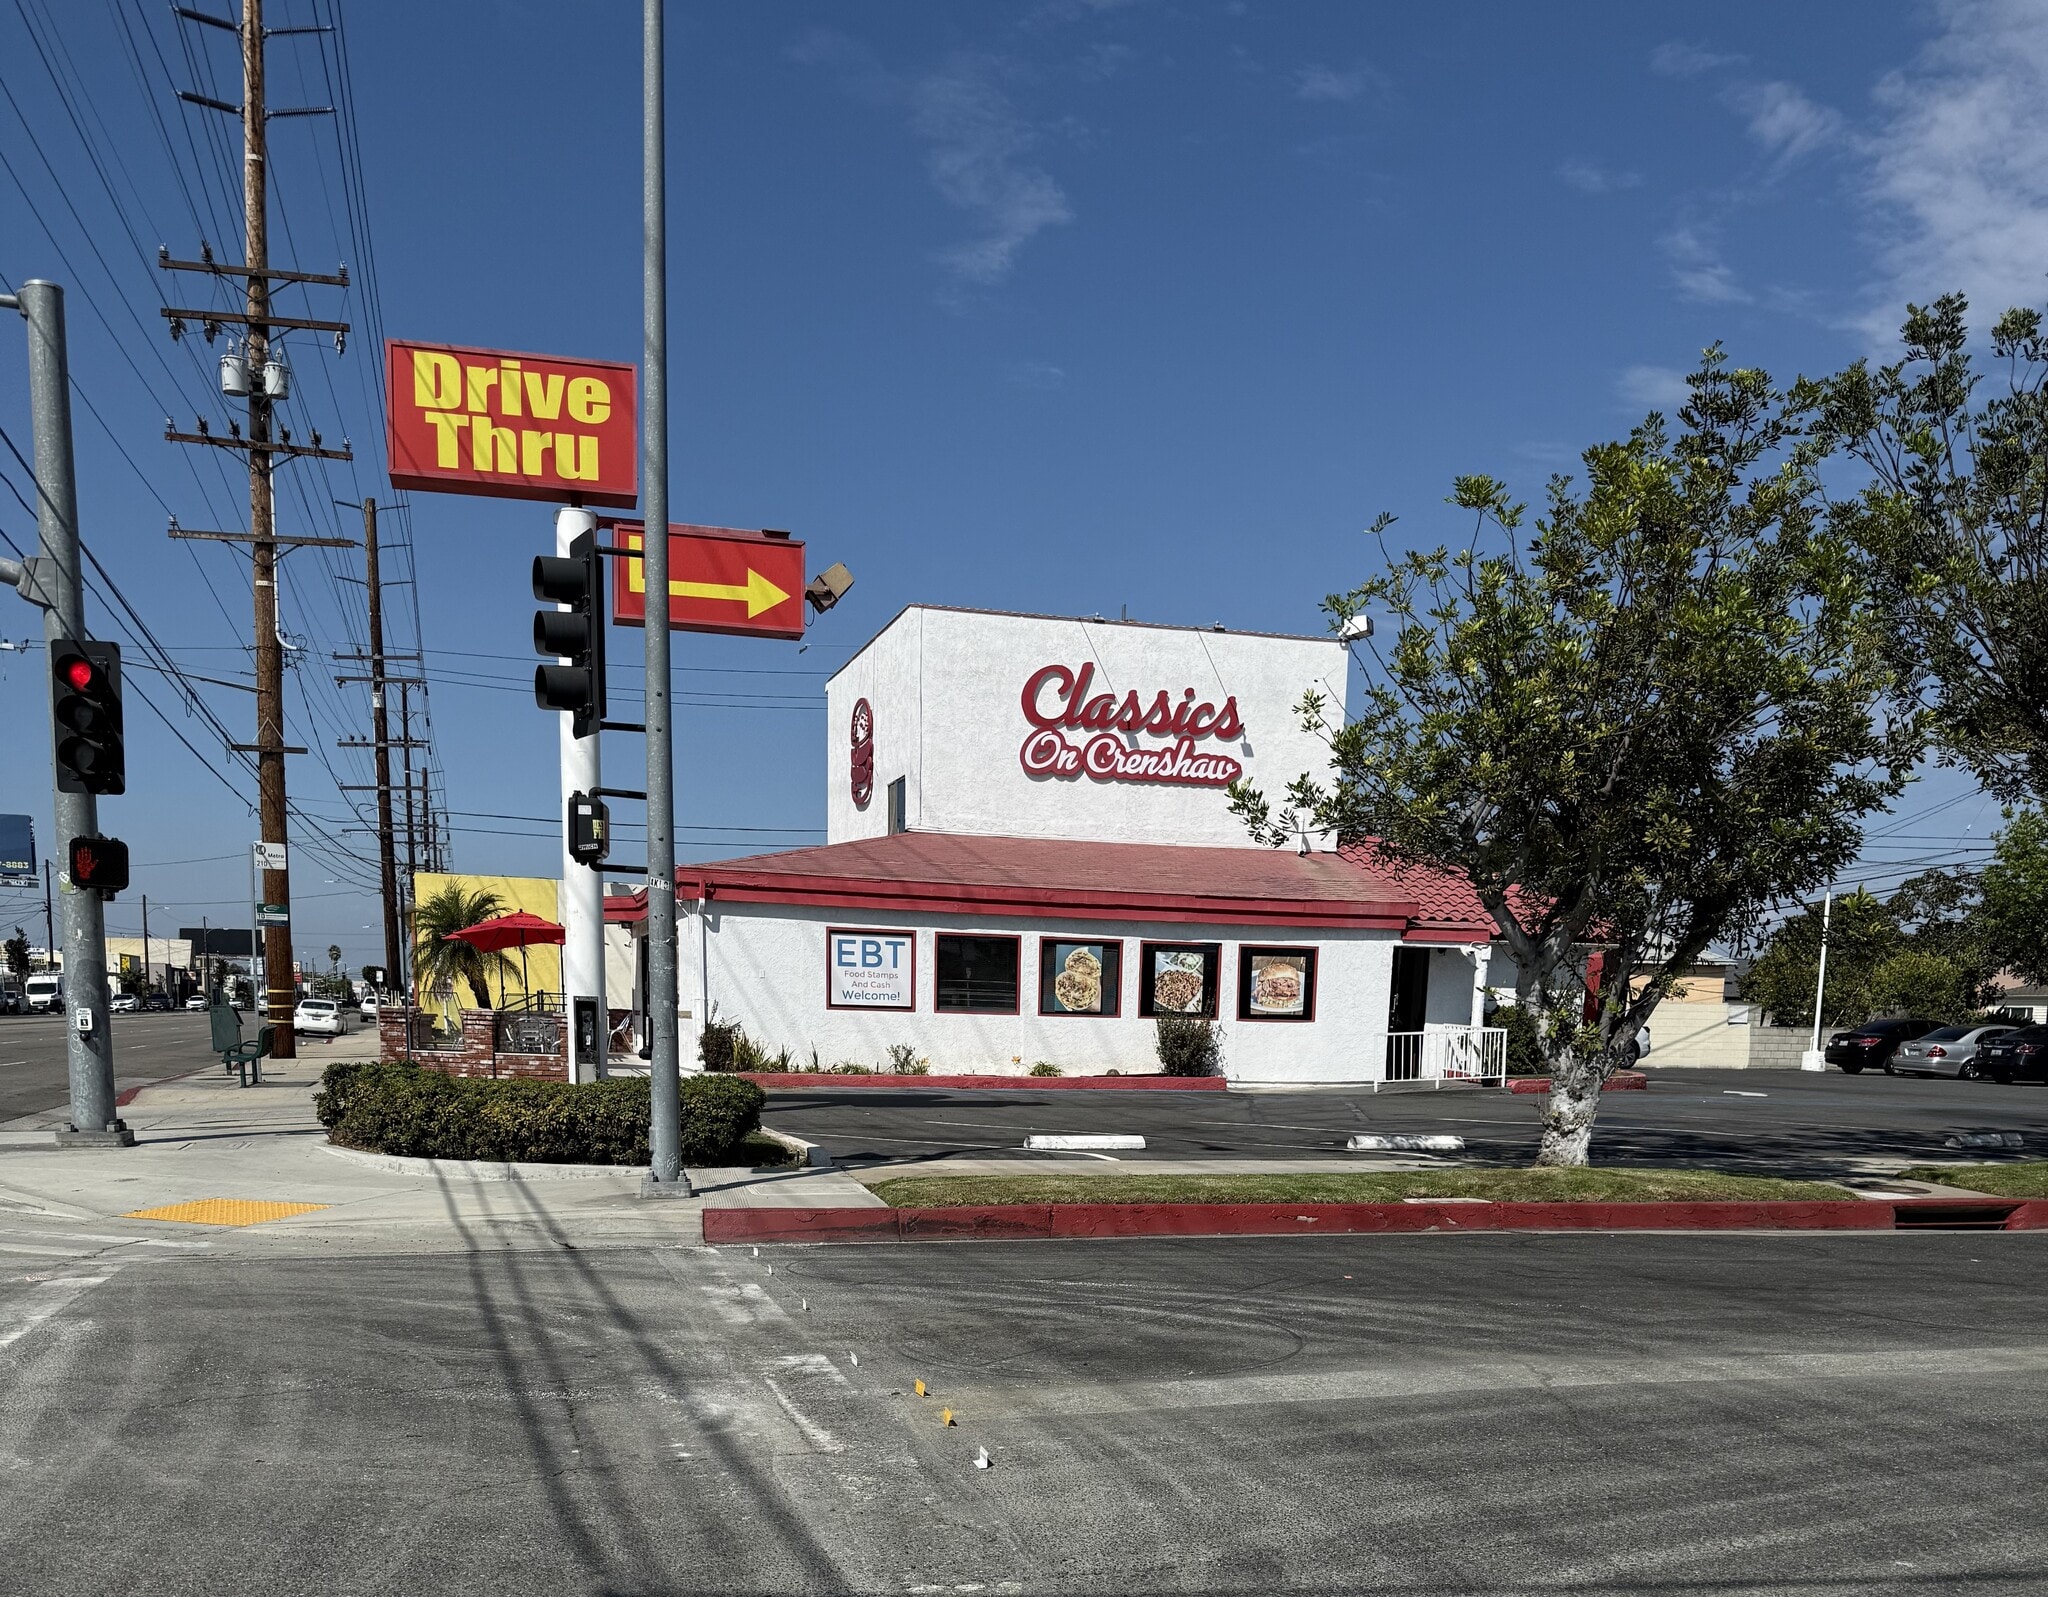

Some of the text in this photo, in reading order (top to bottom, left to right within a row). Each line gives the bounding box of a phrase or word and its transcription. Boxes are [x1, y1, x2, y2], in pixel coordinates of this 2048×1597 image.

[413, 350, 611, 425] Drive
[424, 411, 599, 482] Thru
[1021, 662, 1242, 739] Classics
[1023, 730, 1239, 780] On Crenshaw
[837, 938, 906, 969] EBT
[842, 989, 900, 1001] Welcome!
[844, 970, 899, 980] Food Stamps
[851, 980, 891, 989] And Cash
